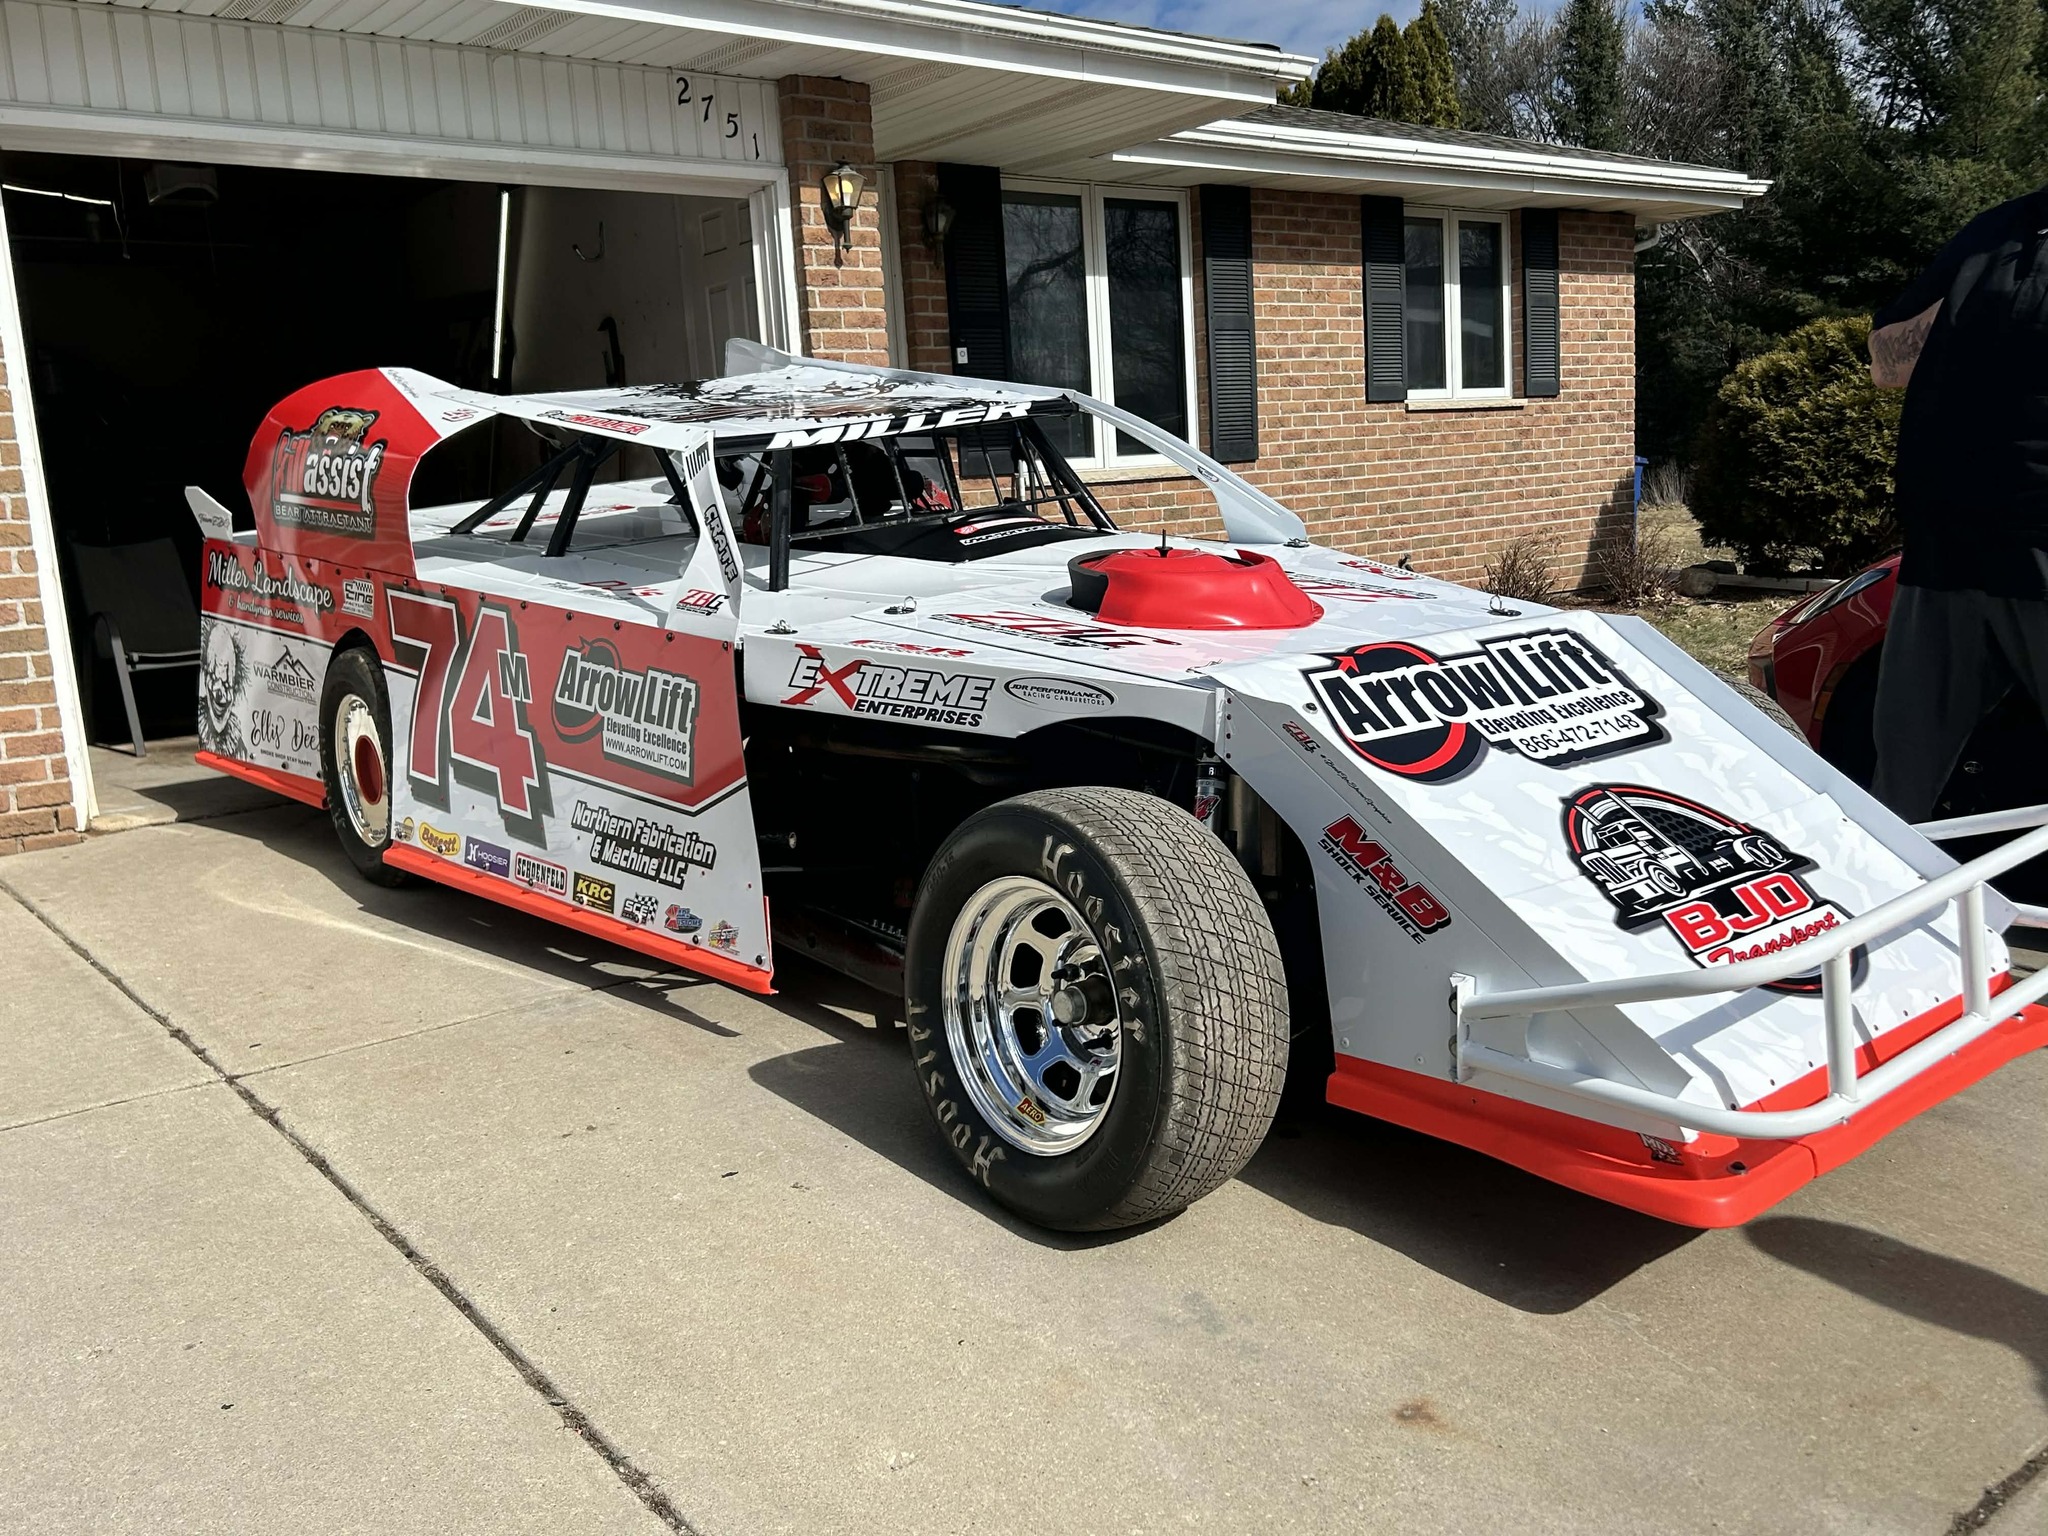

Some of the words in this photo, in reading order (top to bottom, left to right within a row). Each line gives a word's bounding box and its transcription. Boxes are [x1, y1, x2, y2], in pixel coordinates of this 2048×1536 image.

[766, 402, 1032, 450] MILLER
[275, 505, 300, 518] BEAR
[304, 509, 371, 530] ATTRACTANT
[704, 504, 739, 583] CRATE
[208, 551, 249, 589] Miller
[252, 560, 332, 615] Landscape
[237, 595, 273, 617] handyman
[275, 609, 304, 624] services
[253, 664, 315, 692] WARMBIER
[1030, 686, 1102, 699] PERFORMANCE
[853, 699, 983, 727] ENTERPRISES
[1023, 691, 1051, 700] RACING
[1054, 694, 1105, 706] CARBURETORS
[1476, 705, 1554, 736] Elevating
[1552, 689, 1637, 720] Excellence
[251, 709, 285, 750] Ellis
[606, 717, 641, 742] Elevating
[643, 728, 687, 755] Excellence
[1518, 714, 1640, 754] 866-472-7148
[605, 736, 687, 772] WWW.ARROWLIFT.COM
[572, 801, 632, 840] Northern
[632, 818, 716, 865] Fabrication
[478, 851, 508, 868] HOOSIER
[517, 857, 565, 891] SCHOENFELD
[591, 835, 602, 858] &
[602, 838, 659, 877] Machine
[659, 856, 687, 885] LLC
[1322, 813, 1450, 931] M&B
[576, 879, 613, 902] KRC
[624, 900, 648, 917] SCE
[1317, 839, 1365, 884] SHOCK
[1364, 885, 1426, 945] SERVICE
[1662, 872, 1814, 954] BJD
[1020, 1103, 1042, 1121] AERO
